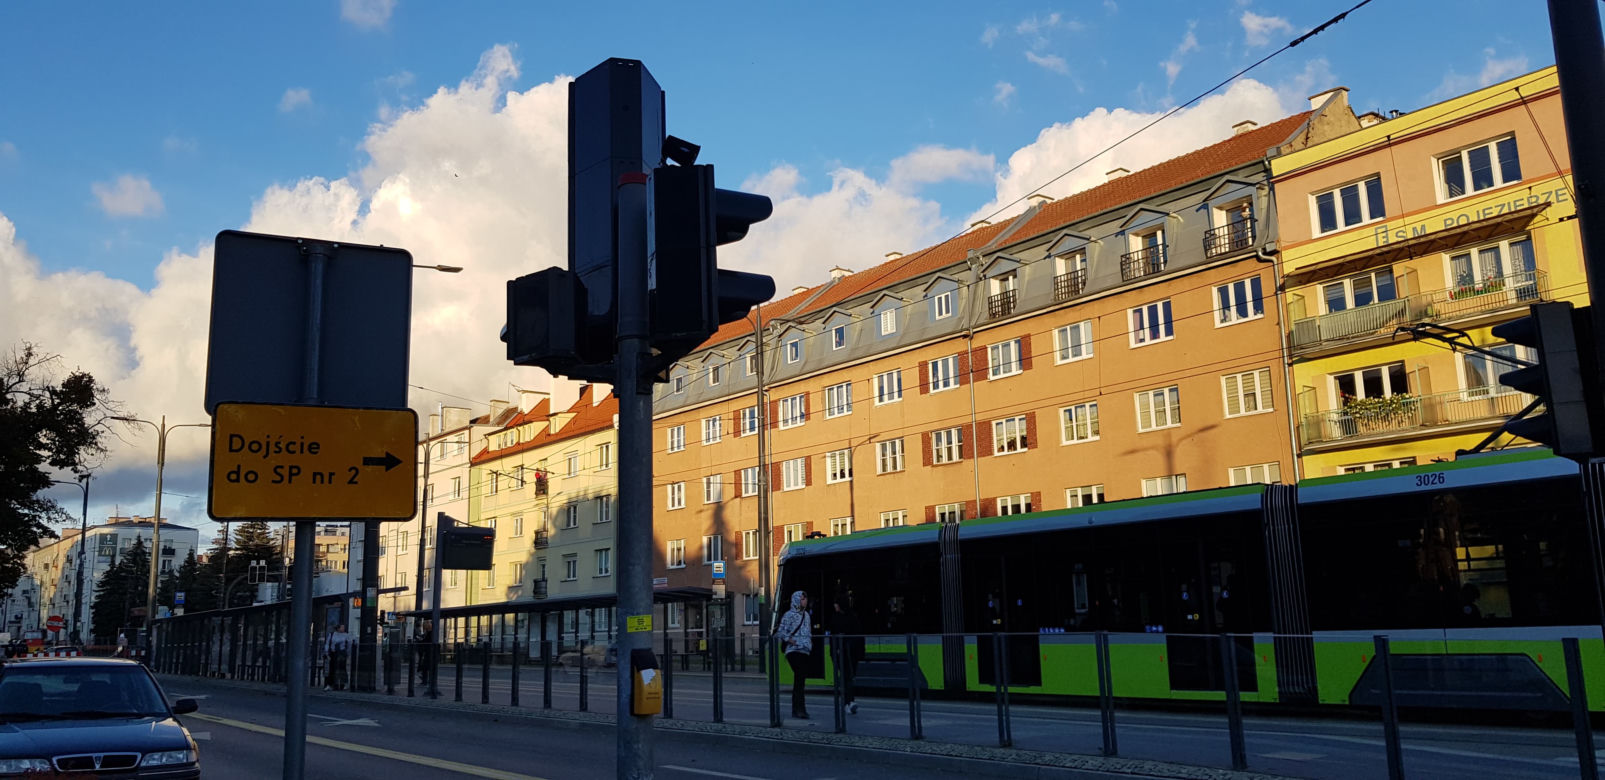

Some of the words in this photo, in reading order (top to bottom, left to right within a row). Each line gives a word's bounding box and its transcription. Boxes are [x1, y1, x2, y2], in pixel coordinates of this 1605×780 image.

[1443, 187, 1569, 229] POJEZIERZE
[229, 433, 321, 459] Dojście
[226, 464, 259, 484] do
[271, 465, 302, 485] SP
[312, 471, 336, 485] nr
[347, 466, 360, 485] 2
[1415, 472, 1445, 487] 3026
